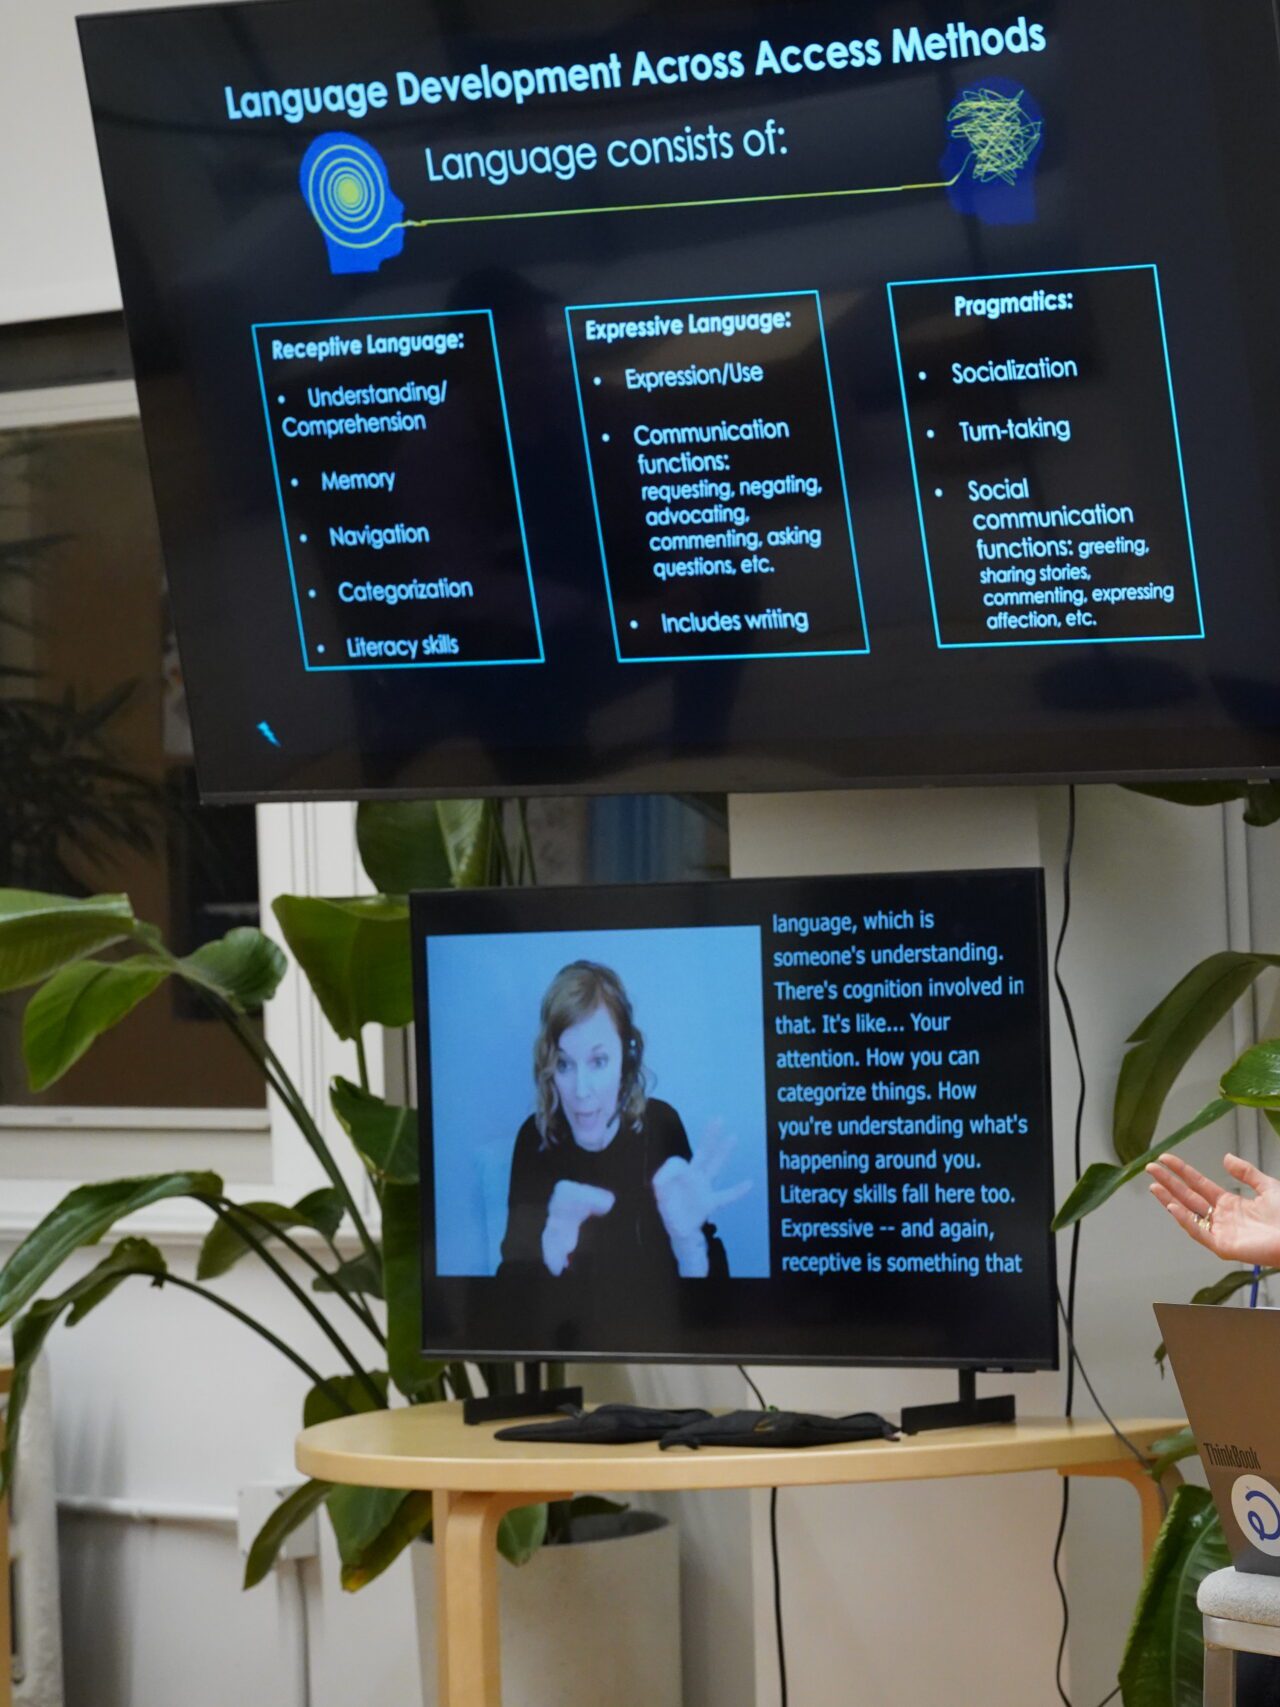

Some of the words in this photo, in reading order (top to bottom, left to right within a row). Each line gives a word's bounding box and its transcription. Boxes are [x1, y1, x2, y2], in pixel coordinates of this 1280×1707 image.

[225, 81, 388, 123] Language
[396, 53, 621, 106] Development
[632, 51, 745, 86] Across
[755, 39, 882, 75] Access
[892, 16, 1046, 63] Methods
[425, 143, 597, 185] Language
[607, 125, 734, 167] consists
[743, 119, 787, 157] of:
[955, 290, 1073, 319] Pragmatics:
[586, 315, 684, 343] Expressive
[688, 311, 791, 336] Language:
[272, 335, 363, 362] Receptive
[367, 333, 464, 357] Language:
[625, 362, 763, 392] Expression/Use
[952, 357, 1077, 384] Socialization
[308, 380, 447, 407] Understanding/
[282, 411, 426, 439] Comprehension
[634, 418, 789, 446] Communication
[959, 417, 1071, 442] Turn-taking
[638, 452, 730, 474] functions:
[322, 471, 395, 491] Memory
[642, 479, 735, 503] requesting,
[740, 474, 822, 499] negating,
[968, 478, 1029, 501] Social
[646, 504, 750, 526] advocating,
[973, 503, 1134, 530] communication
[329, 523, 430, 549] Navigation
[649, 529, 763, 551] commenting,
[767, 526, 821, 548] asking
[976, 536, 1073, 560] functions:
[1078, 536, 1149, 559] greeting,
[653, 557, 736, 581] questions,
[741, 554, 775, 573] etc.
[980, 566, 1036, 586] sharing
[1039, 563, 1091, 581] stories,
[339, 578, 473, 605] Categorization
[983, 586, 1088, 607] commenting,
[1092, 582, 1174, 604] expressing
[661, 611, 742, 633] Includes
[744, 608, 809, 633] writing
[987, 611, 1061, 629] affection,
[1066, 610, 1097, 627] etc.
[347, 637, 418, 659] Literacy
[422, 634, 459, 655] skills
[773, 914, 857, 936] language,
[864, 910, 913, 929] which
[920, 910, 934, 928] is
[774, 946, 865, 967] someone's
[871, 942, 1003, 965] understanding.
[774, 981, 838, 1000] There's
[843, 979, 922, 1002] cognition
[929, 976, 1002, 996] involved
[1009, 977, 1023, 994] in
[775, 1016, 815, 1034] that.
[823, 1014, 850, 1033] It's
[856, 1014, 904, 1032] like...
[911, 1013, 950, 1031] Your
[777, 1049, 859, 1068] attention.
[867, 1048, 904, 1066] How
[910, 1051, 942, 1070] you
[949, 1050, 979, 1065] can
[777, 1083, 866, 1105] categorize
[872, 1082, 931, 1104] things.
[939, 1081, 976, 1099] How
[779, 1116, 832, 1139] you're
[838, 1115, 963, 1138] understanding
[970, 1114, 1028, 1133] what's
[780, 1151, 869, 1173] happening
[875, 1150, 936, 1169] around
[943, 1154, 980, 1172] you.
[781, 1185, 848, 1207] Literacy
[854, 1184, 897, 1203] skills
[902, 1184, 928, 1203] fall
[935, 1184, 975, 1203] here
[981, 1185, 1015, 1203] too.
[782, 1218, 873, 1241] Expressive
[901, 1218, 933, 1237] and
[940, 1219, 994, 1242] again,
[782, 1253, 861, 1274] receptive
[867, 1253, 881, 1271] is
[887, 1253, 979, 1276] something
[985, 1253, 1022, 1272] that
[1203, 1442, 1262, 1470] ThinkBook
